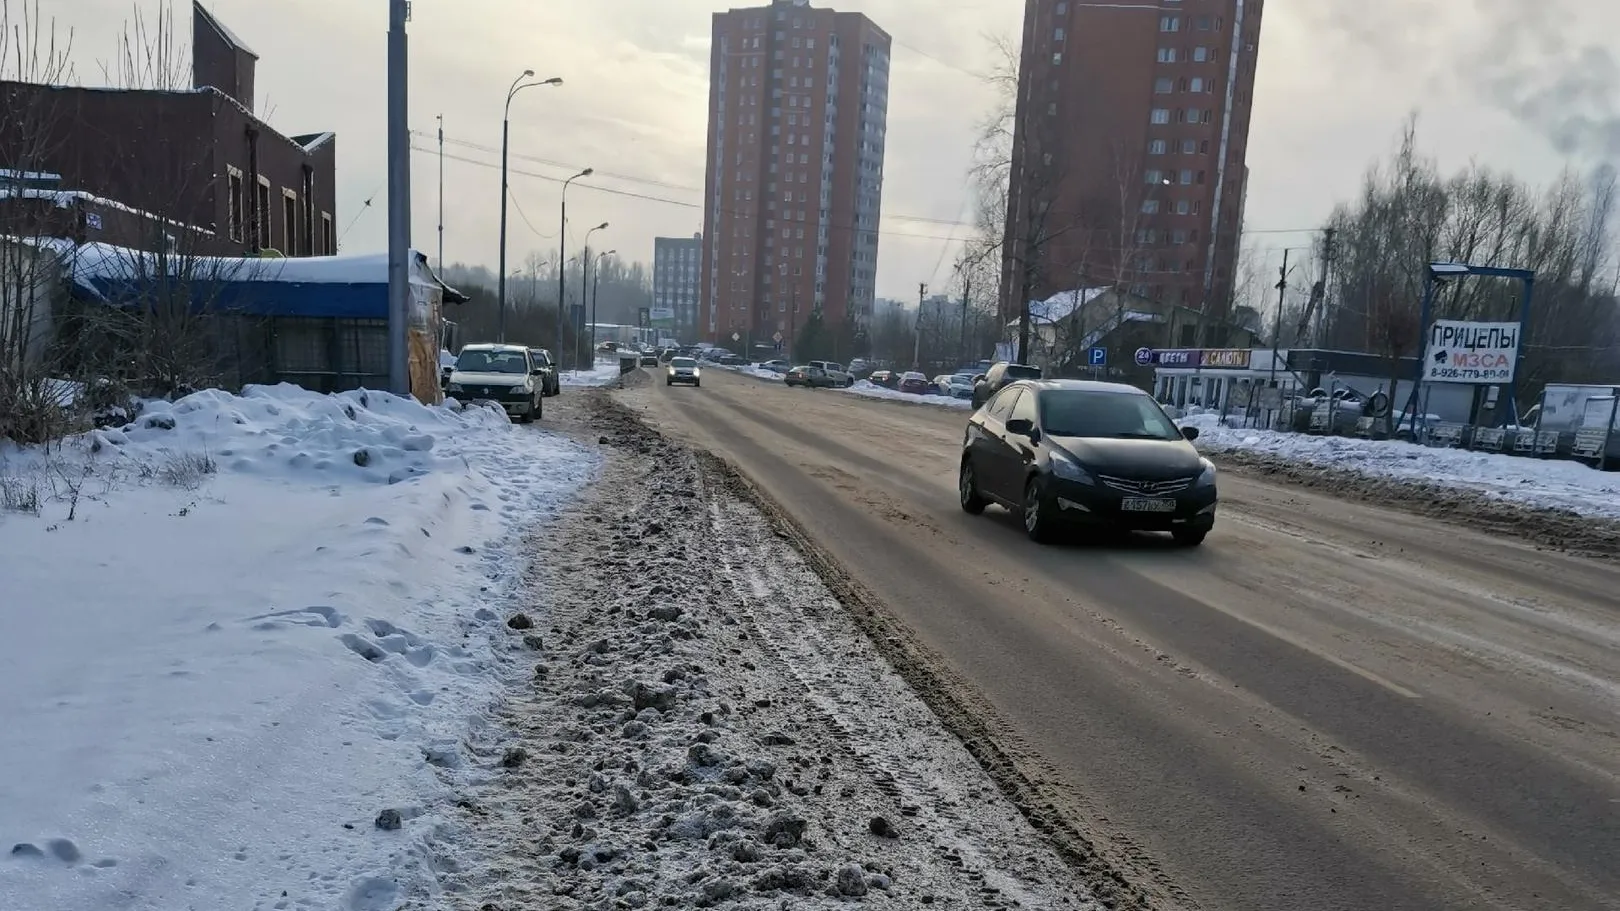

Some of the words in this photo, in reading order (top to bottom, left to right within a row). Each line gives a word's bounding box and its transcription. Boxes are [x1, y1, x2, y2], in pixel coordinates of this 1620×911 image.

[1432, 325, 1516, 352] ПРИЦЕПЫ
[1094, 350, 1103, 363] P
[1138, 350, 1149, 359] 24
[1453, 353, 1509, 368] МЗСА
